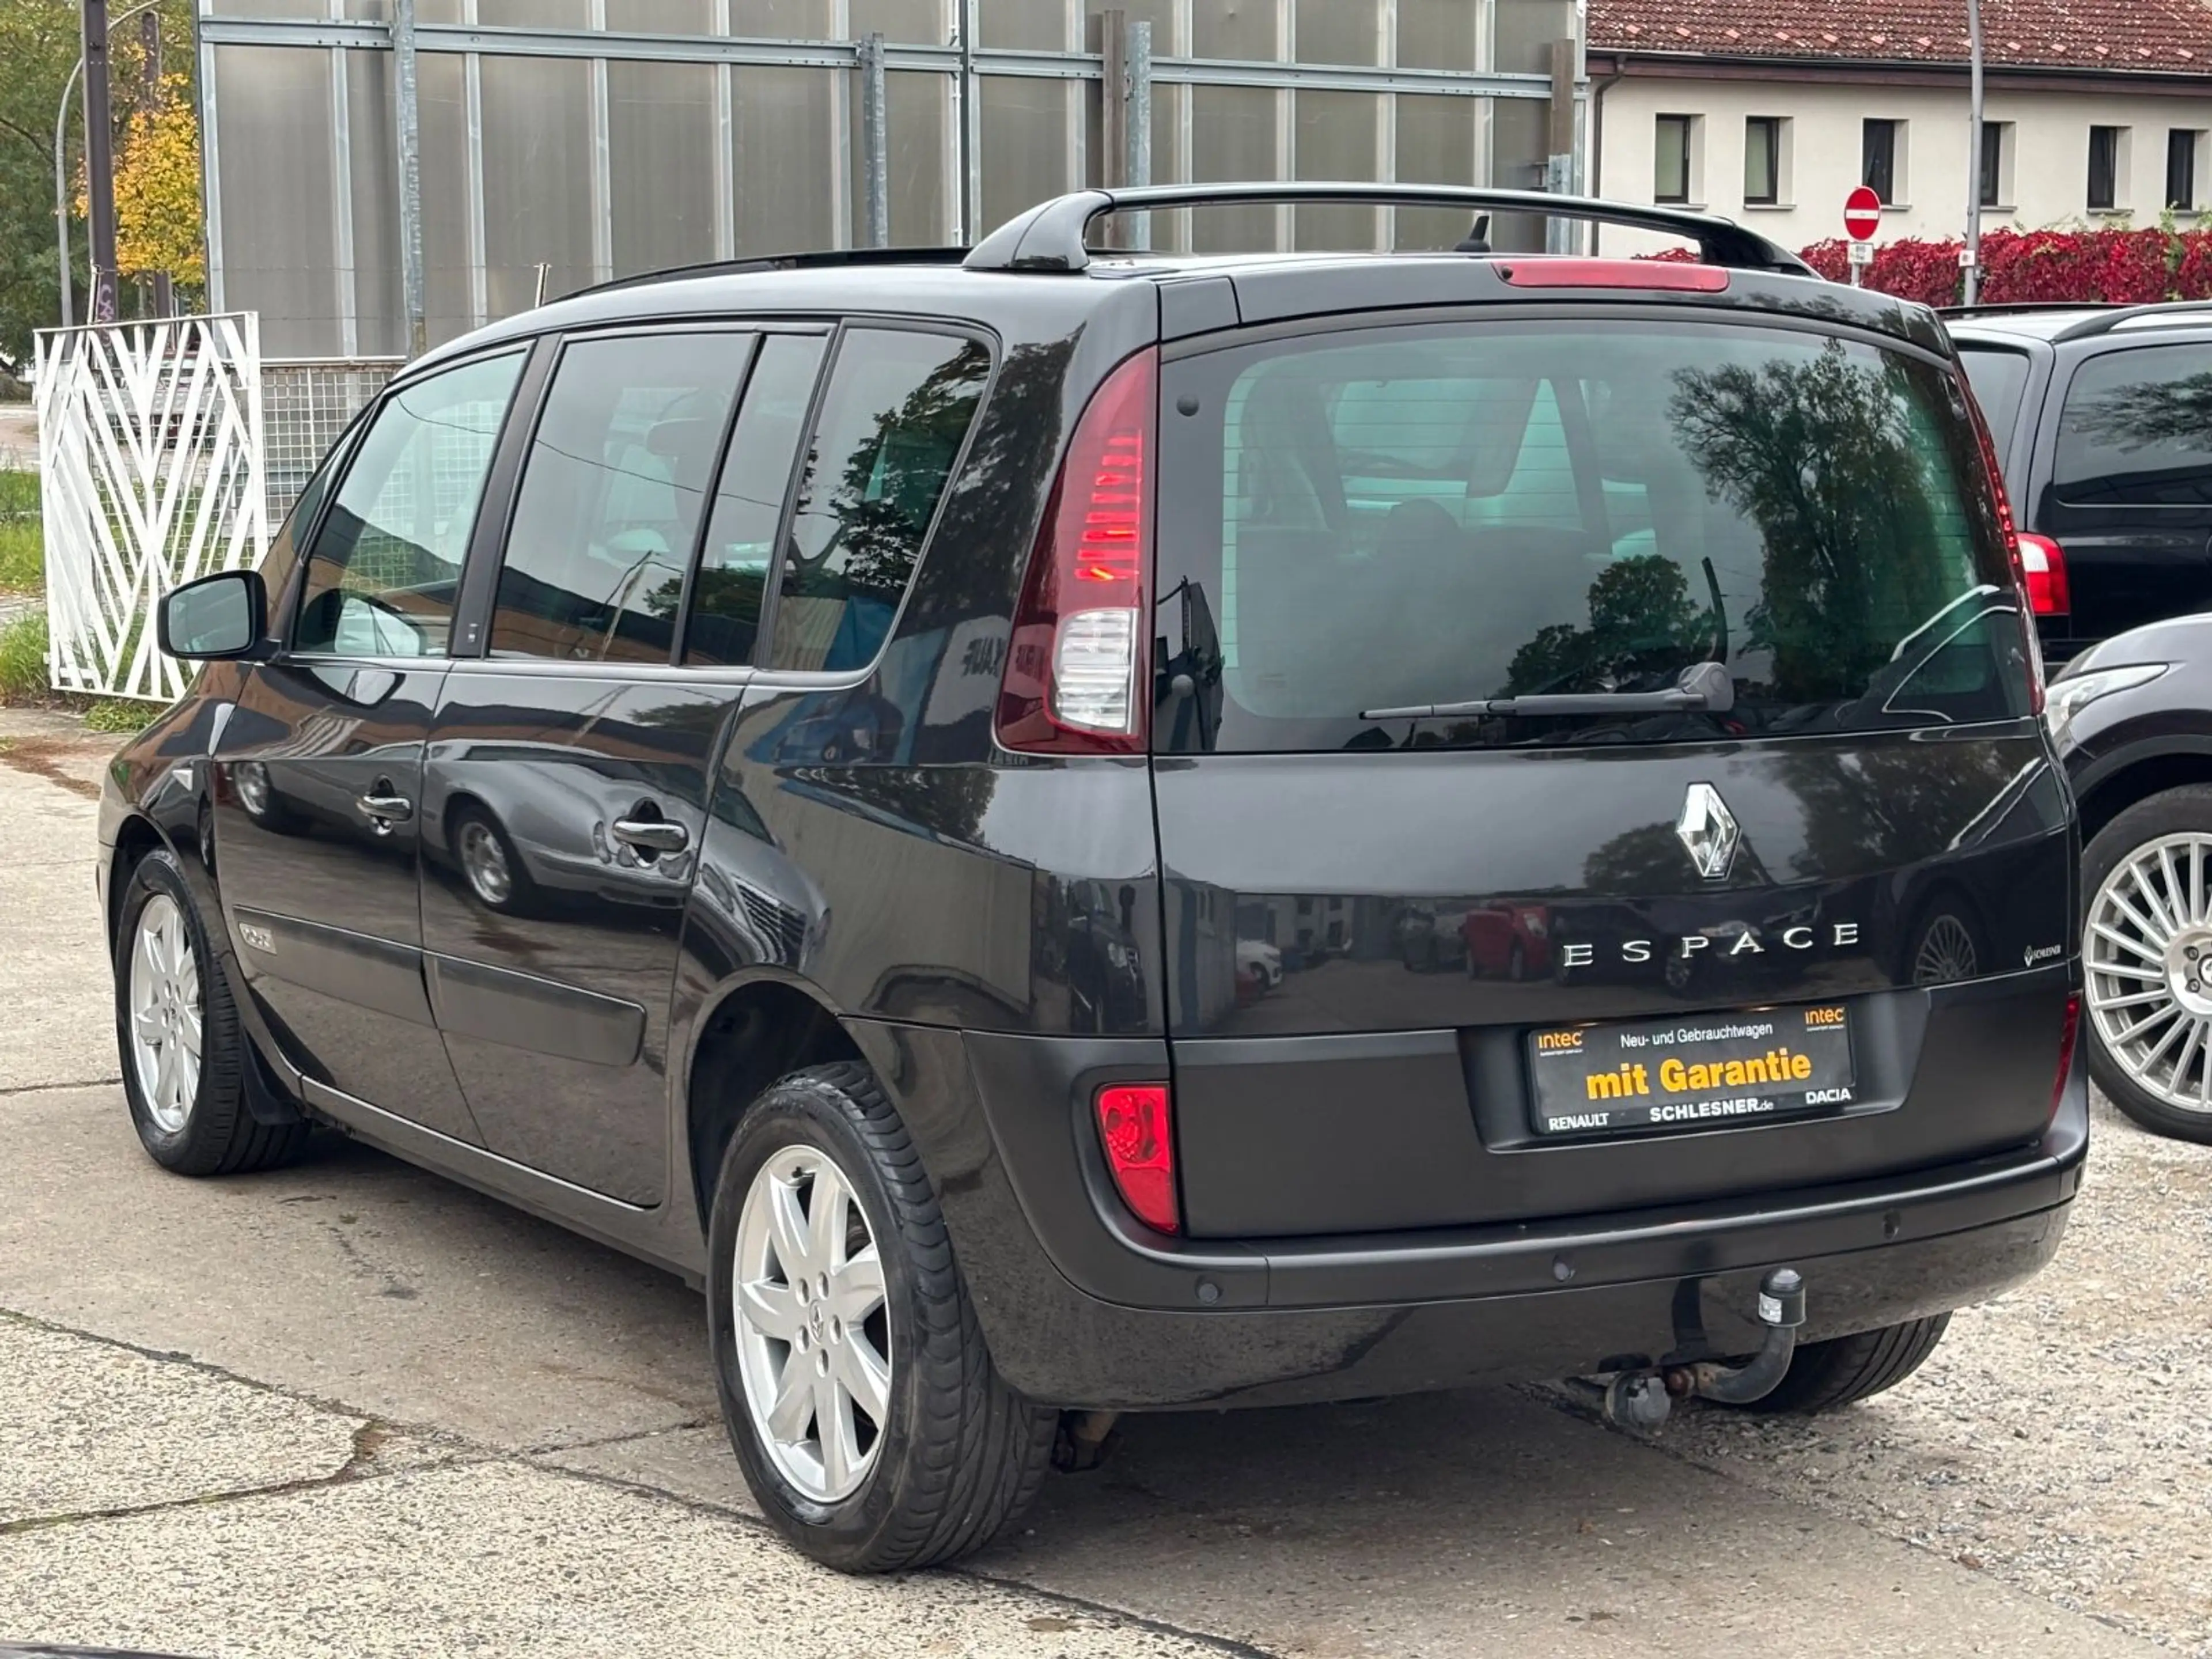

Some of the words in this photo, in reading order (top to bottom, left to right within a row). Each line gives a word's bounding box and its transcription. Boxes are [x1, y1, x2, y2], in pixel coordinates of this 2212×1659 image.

[1563, 923, 1858, 966] ESPACE
[2033, 944, 2061, 960] SCHLESN
[1620, 1035, 1649, 1048] Neu-
[1652, 1031, 1674, 1045] und
[1677, 1024, 1773, 1042] Gebrauchtwagen
[1586, 1063, 1649, 1100] mit
[1660, 1047, 1811, 1092] Garantie
[1805, 1088, 1851, 1104] DACIA
[1548, 1113, 1609, 1131] RENAULT
[1650, 1098, 1774, 1122] SCHLESNER.de
